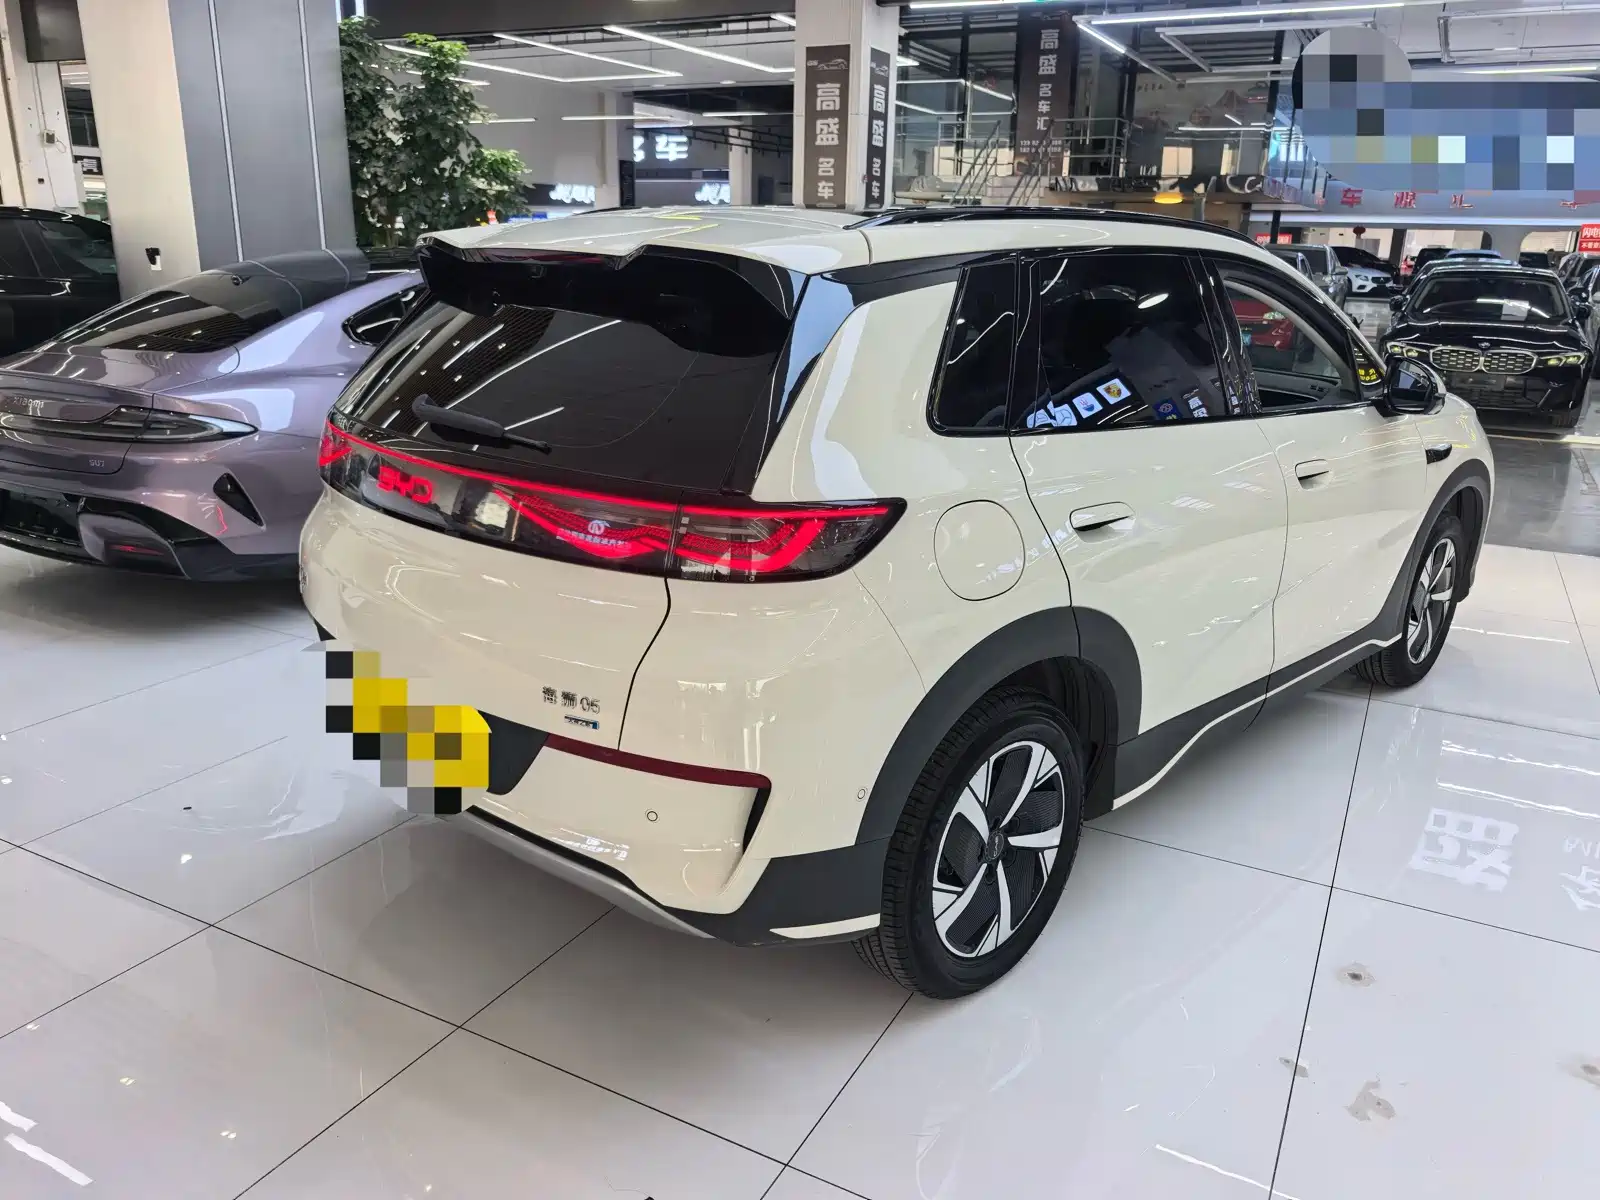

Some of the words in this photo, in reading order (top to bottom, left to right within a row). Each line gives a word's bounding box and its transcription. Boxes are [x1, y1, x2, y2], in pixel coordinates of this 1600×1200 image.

[1036, 29, 1059, 130] 高盛名车汇
[815, 83, 841, 200] 高盛名车
[871, 84, 886, 199] 高盛名车
[89, 459, 105, 467] SU7
[376, 465, 433, 504] BYD
